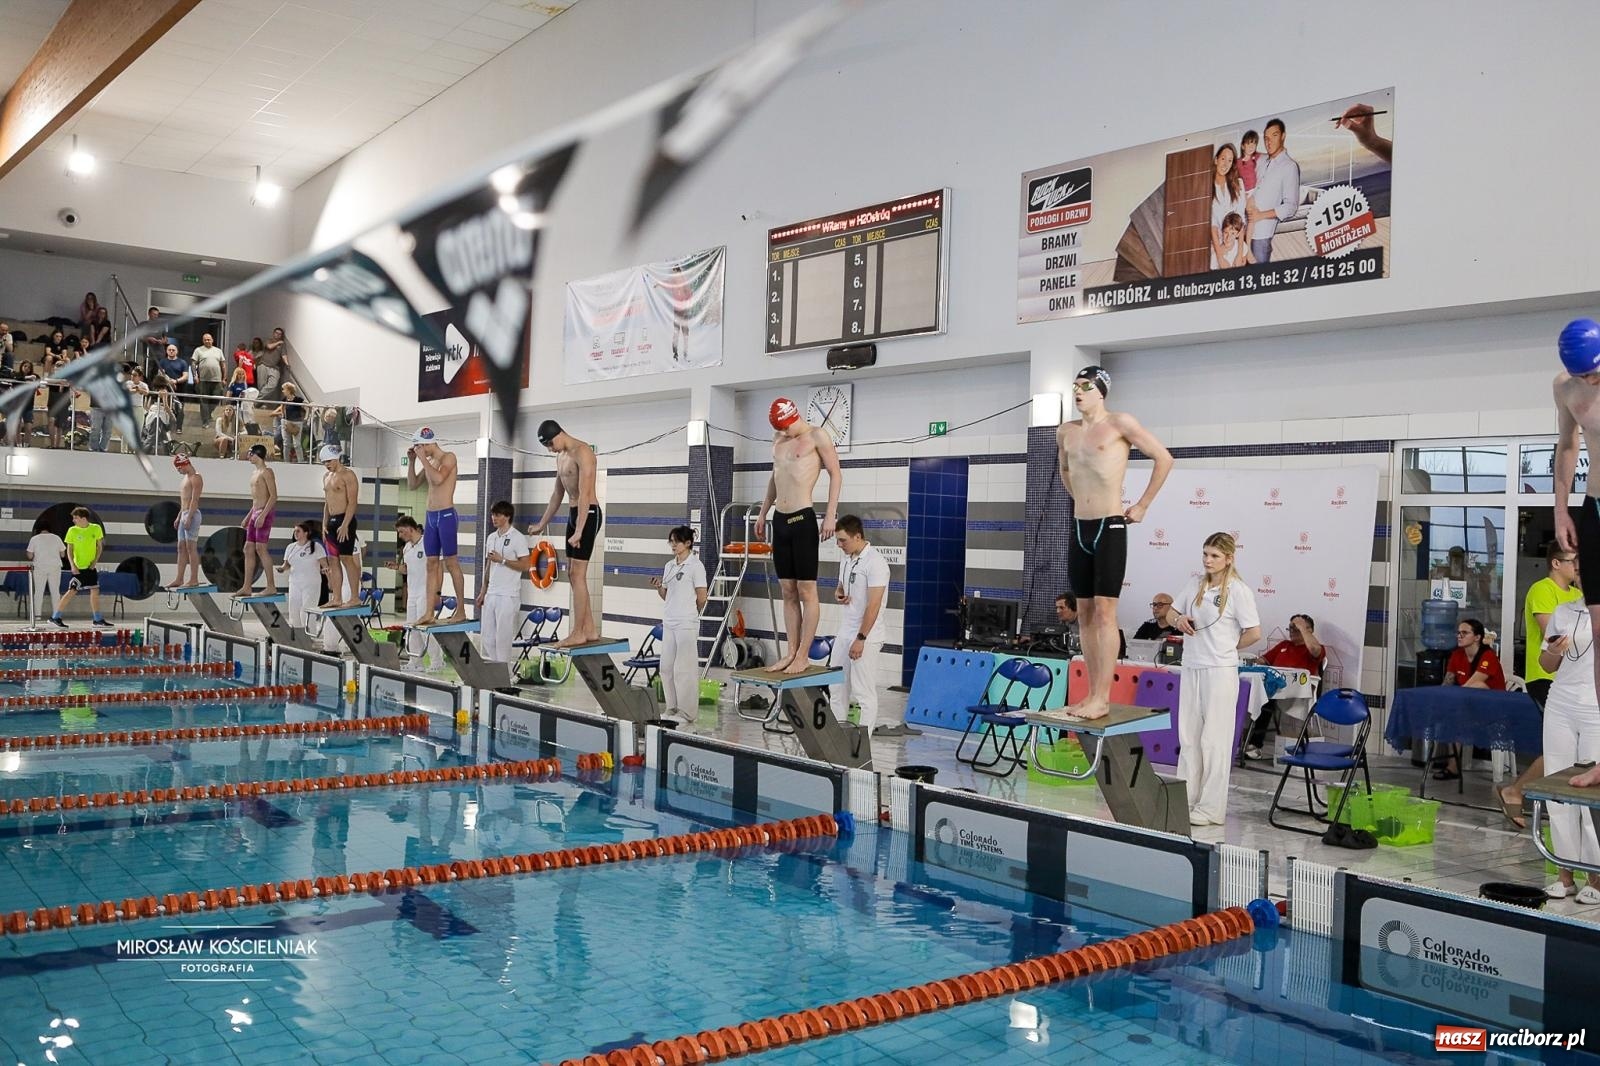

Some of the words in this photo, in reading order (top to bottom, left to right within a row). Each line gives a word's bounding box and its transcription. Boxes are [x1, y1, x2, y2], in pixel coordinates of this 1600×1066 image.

[1065, 207, 1089, 221] DRZWI
[1315, 194, 1363, 227] -15%
[852, 235, 861, 245] TOR
[866, 229, 886, 242] MIEJSCE
[925, 217, 939, 229] CZAS
[1321, 223, 1372, 253] MONTAŻEM
[1041, 231, 1078, 251] BRAMY
[854, 254, 864, 266] 5.
[1045, 253, 1077, 271] DRZWI
[772, 270, 781, 281] 1.
[853, 276, 863, 289] 6.
[1039, 274, 1076, 292] PANELE
[1088, 284, 1151, 309] RACIBÓRZ
[1157, 286, 1170, 300] ul.
[1173, 278, 1236, 297] Głubczycka
[1238, 274, 1257, 290] 13,
[1260, 271, 1280, 286] tel:
[1283, 268, 1299, 284] 32
[1301, 266, 1308, 283] /
[1310, 263, 1335, 279] 415
[1338, 261, 1355, 276] 25
[1358, 258, 1376, 274] 00
[771, 291, 780, 303] 2.
[853, 299, 862, 311] 7.
[1049, 295, 1075, 311] OKNA
[771, 313, 780, 324] 3.
[851, 321, 861, 333] 8.
[770, 333, 779, 345] 4.
[270, 610, 280, 628] 2
[352, 624, 363, 645] 3
[459, 641, 471, 664] 4
[601, 664, 615, 692] 5
[785, 703, 804, 730] 6
[813, 697, 827, 730] 6
[1129, 746, 1144, 788] 7
[959, 828, 998, 846] Colorado
[960, 839, 974, 848] TIME
[1422, 936, 1490, 964] Colorado
[1424, 950, 1449, 964] TIME
